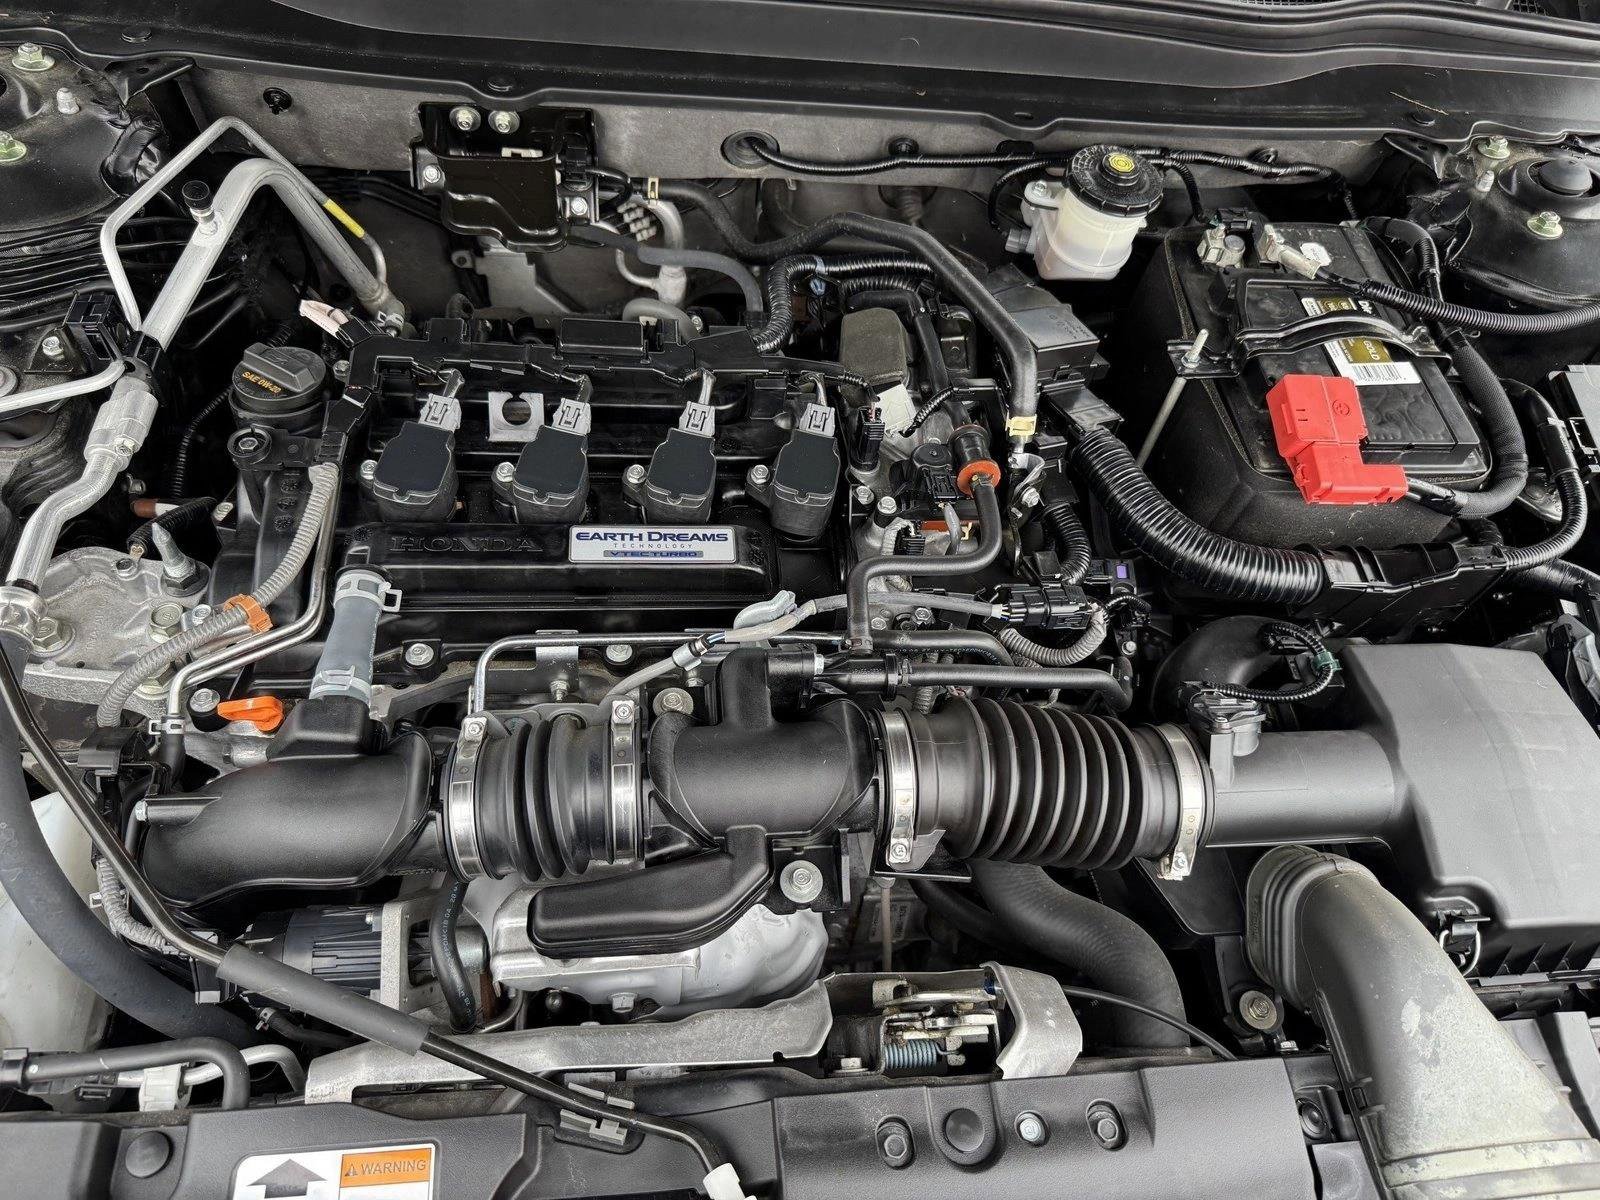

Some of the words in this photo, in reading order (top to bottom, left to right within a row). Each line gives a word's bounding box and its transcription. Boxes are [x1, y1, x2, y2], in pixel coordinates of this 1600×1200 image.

[1363, 340, 1381, 361] GOLD
[242, 371, 260, 383] SAE
[575, 532, 643, 542] EARTH
[647, 531, 729, 542] DREAMS
[390, 537, 543, 552] HONDA
[361, 1159, 427, 1177] WARNING
